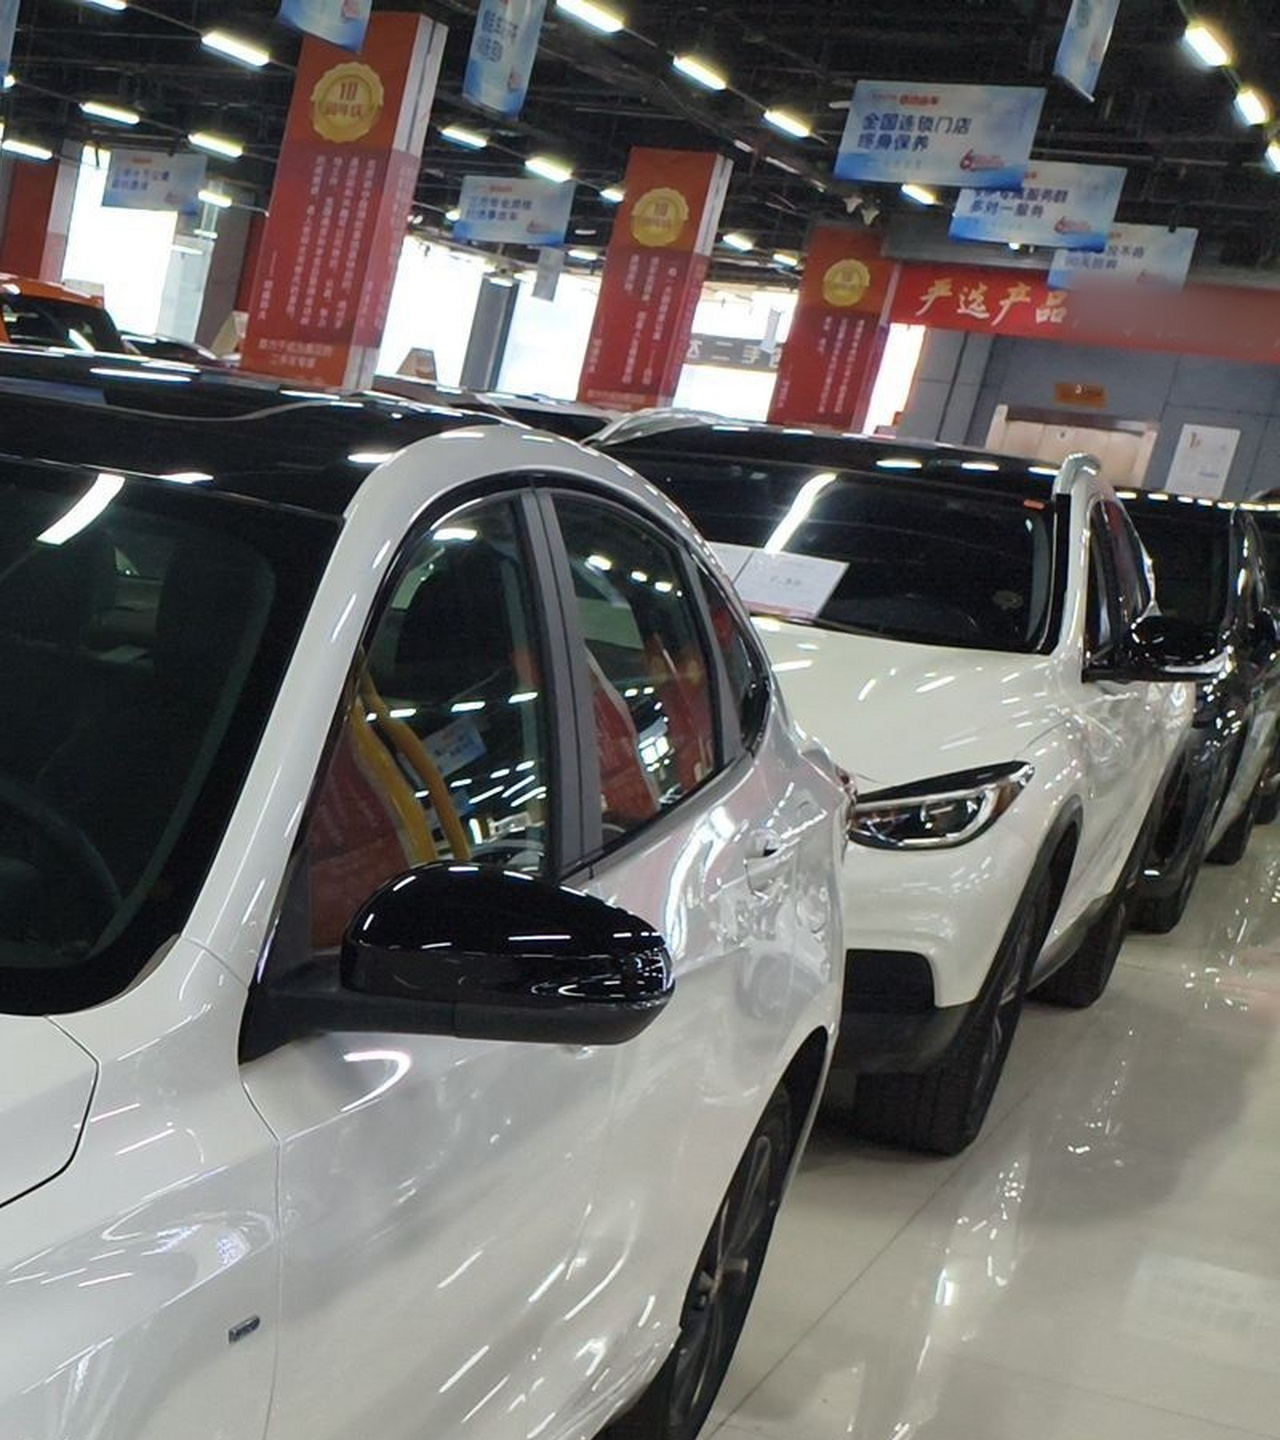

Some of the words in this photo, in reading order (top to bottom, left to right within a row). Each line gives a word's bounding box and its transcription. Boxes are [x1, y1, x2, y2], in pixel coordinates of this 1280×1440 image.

[861, 112, 973, 135] 全国连锁门店
[915, 276, 1070, 327] 严选产品
